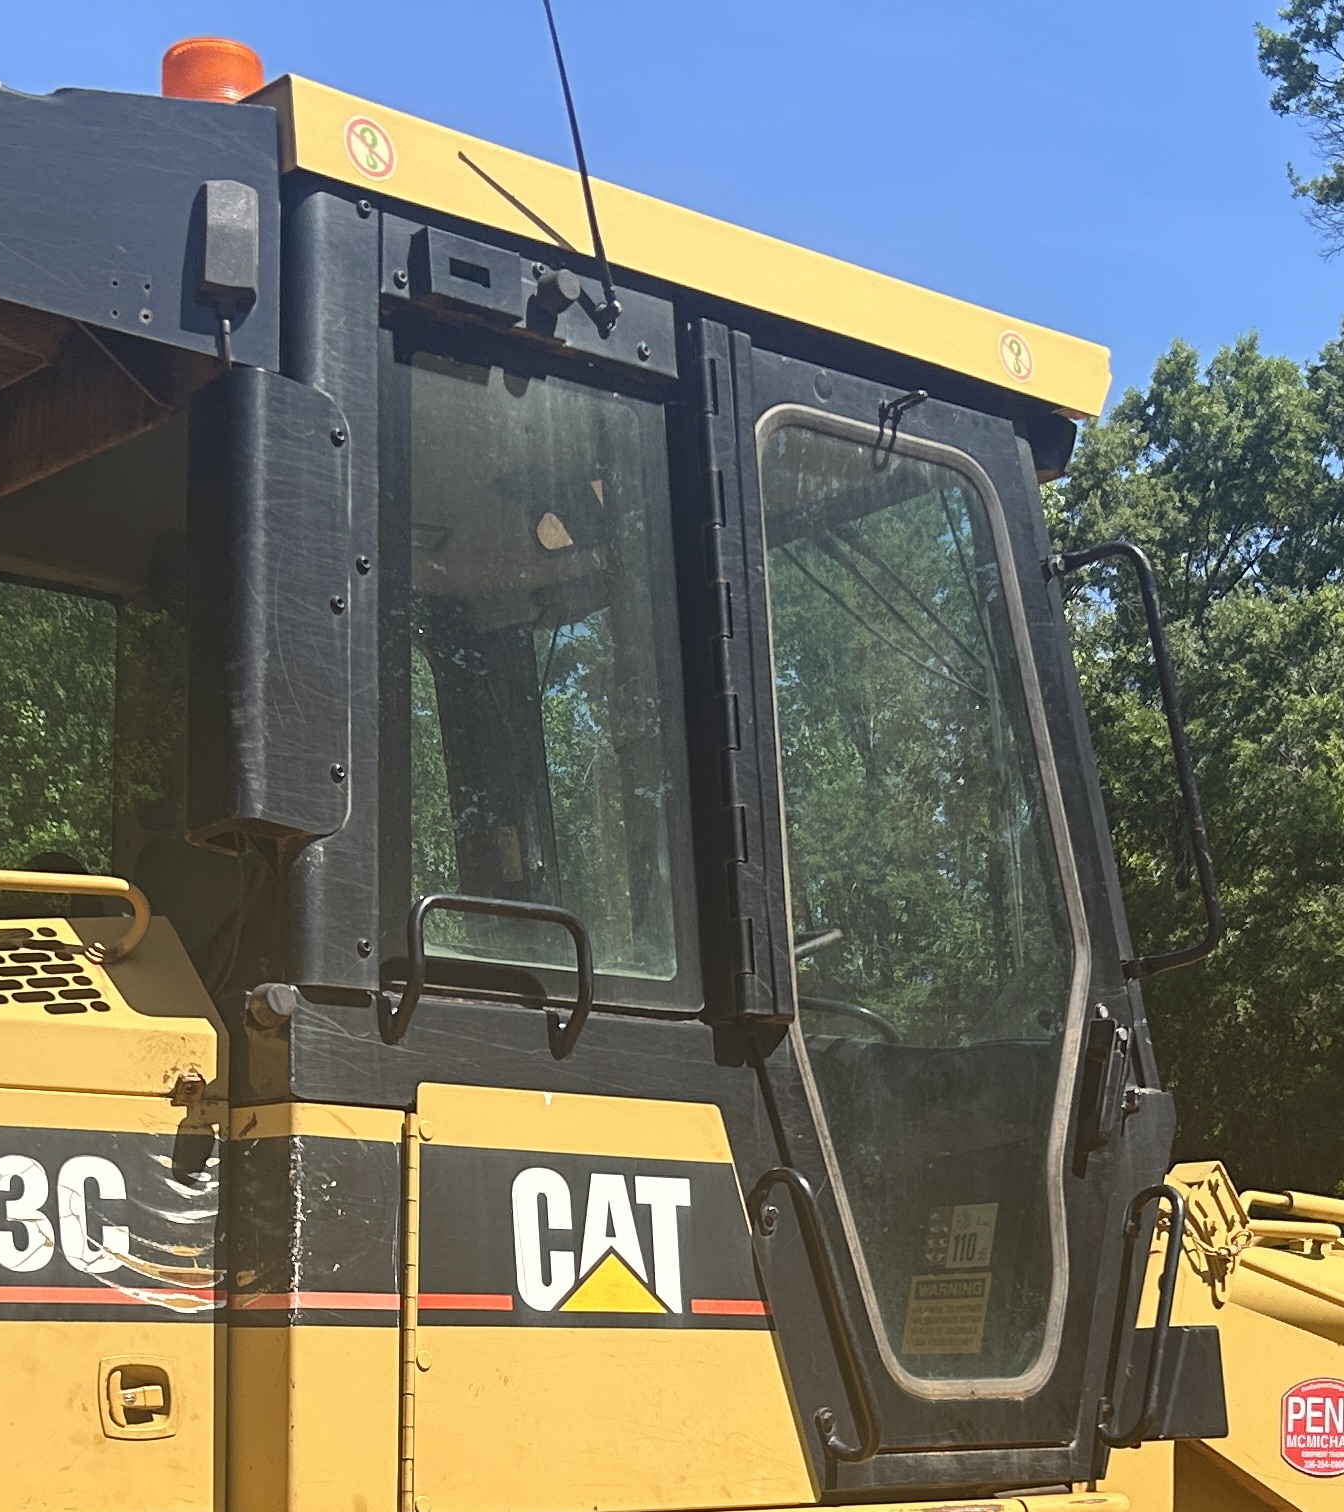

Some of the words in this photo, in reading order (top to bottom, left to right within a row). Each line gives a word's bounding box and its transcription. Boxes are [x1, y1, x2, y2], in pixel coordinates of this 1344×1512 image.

[511, 1166, 691, 1315] CAT
[952, 1231, 978, 1262] 110
[918, 1281, 983, 1297] WARNING
